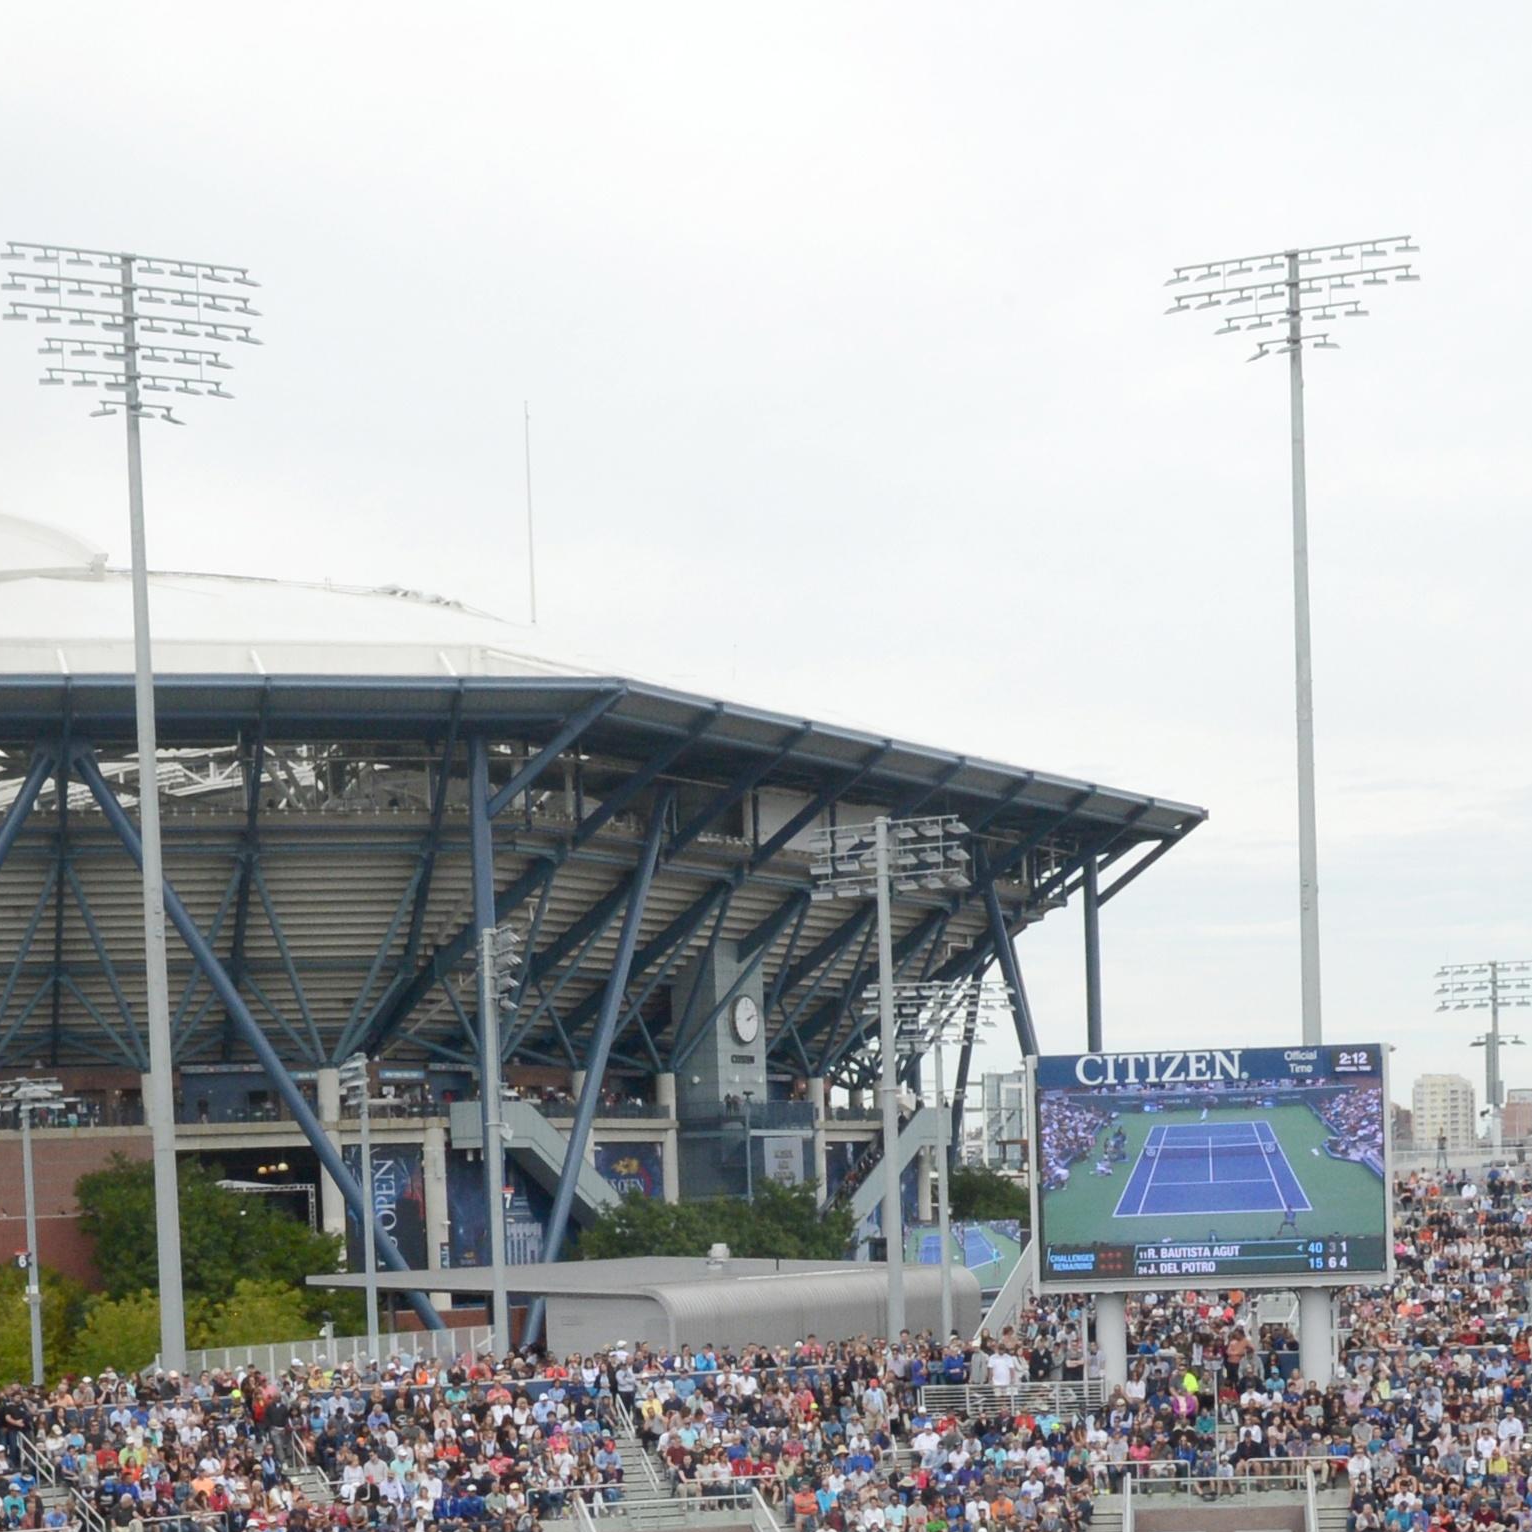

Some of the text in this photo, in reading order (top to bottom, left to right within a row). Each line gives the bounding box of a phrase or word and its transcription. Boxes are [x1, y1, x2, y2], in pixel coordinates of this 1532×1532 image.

[1284, 1050, 1317, 1062] Official
[1339, 1051, 1368, 1066] 2:12
[1075, 1051, 1243, 1086] CITIZEN
[1289, 1063, 1313, 1074] Time
[374, 1158, 398, 1231] OPEN
[504, 1193, 513, 1209] 7
[1148, 1248, 1159, 1258] R.
[1161, 1246, 1210, 1258] BAUTISTA
[1213, 1245, 1240, 1257] AGUT
[1308, 1243, 1323, 1254] 40
[1340, 1241, 1347, 1252] 1
[18, 1254, 27, 1268] 6
[1138, 1256, 1348, 1275] 24 J. DEL POTRO 15 6 4
